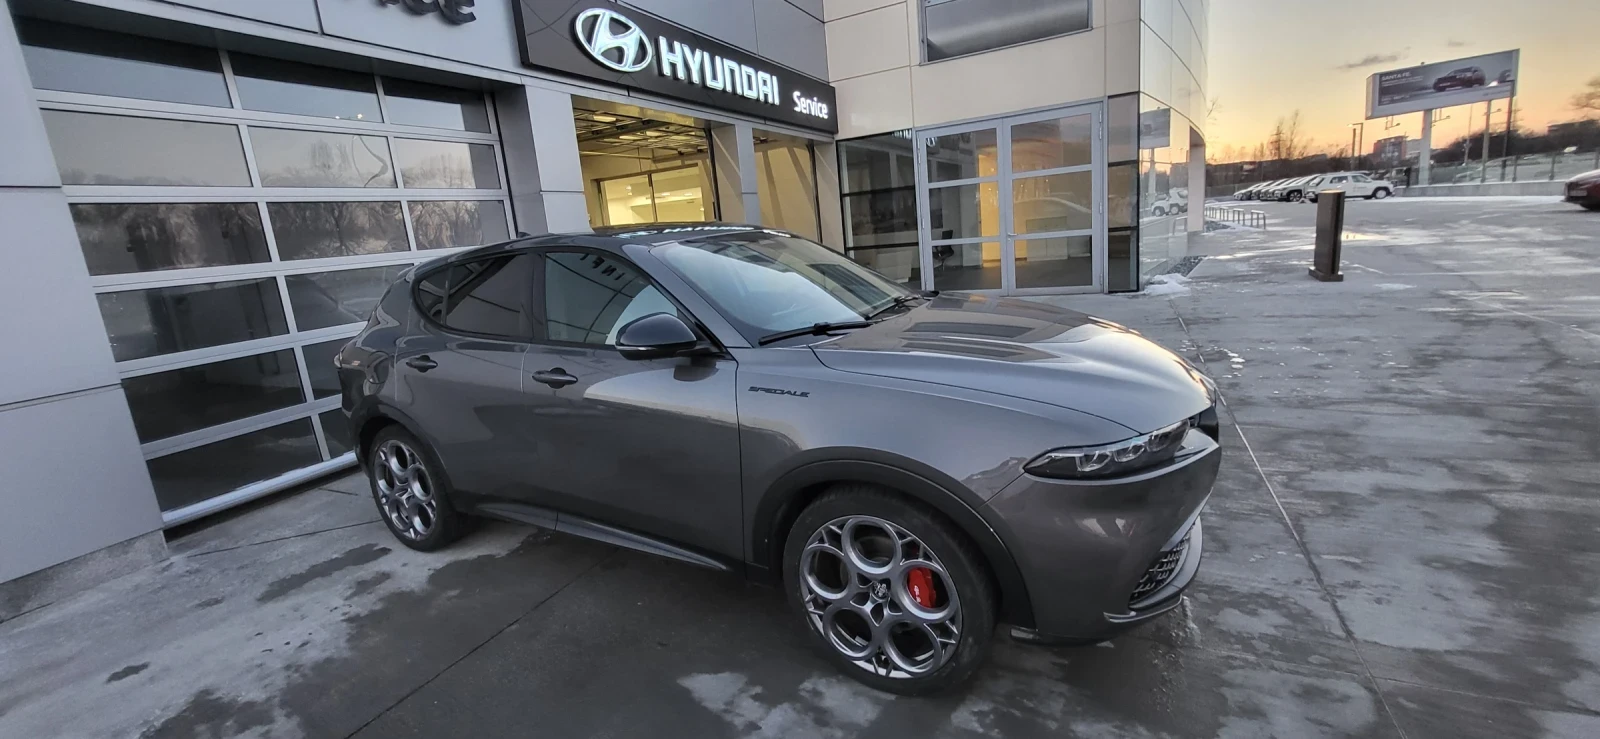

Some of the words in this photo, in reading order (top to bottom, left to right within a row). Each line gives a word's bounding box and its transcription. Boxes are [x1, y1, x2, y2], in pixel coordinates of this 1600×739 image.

[659, 36, 780, 106] HYUNDAI
[792, 90, 829, 120] Service
[1381, 73, 1402, 81] SANTA
